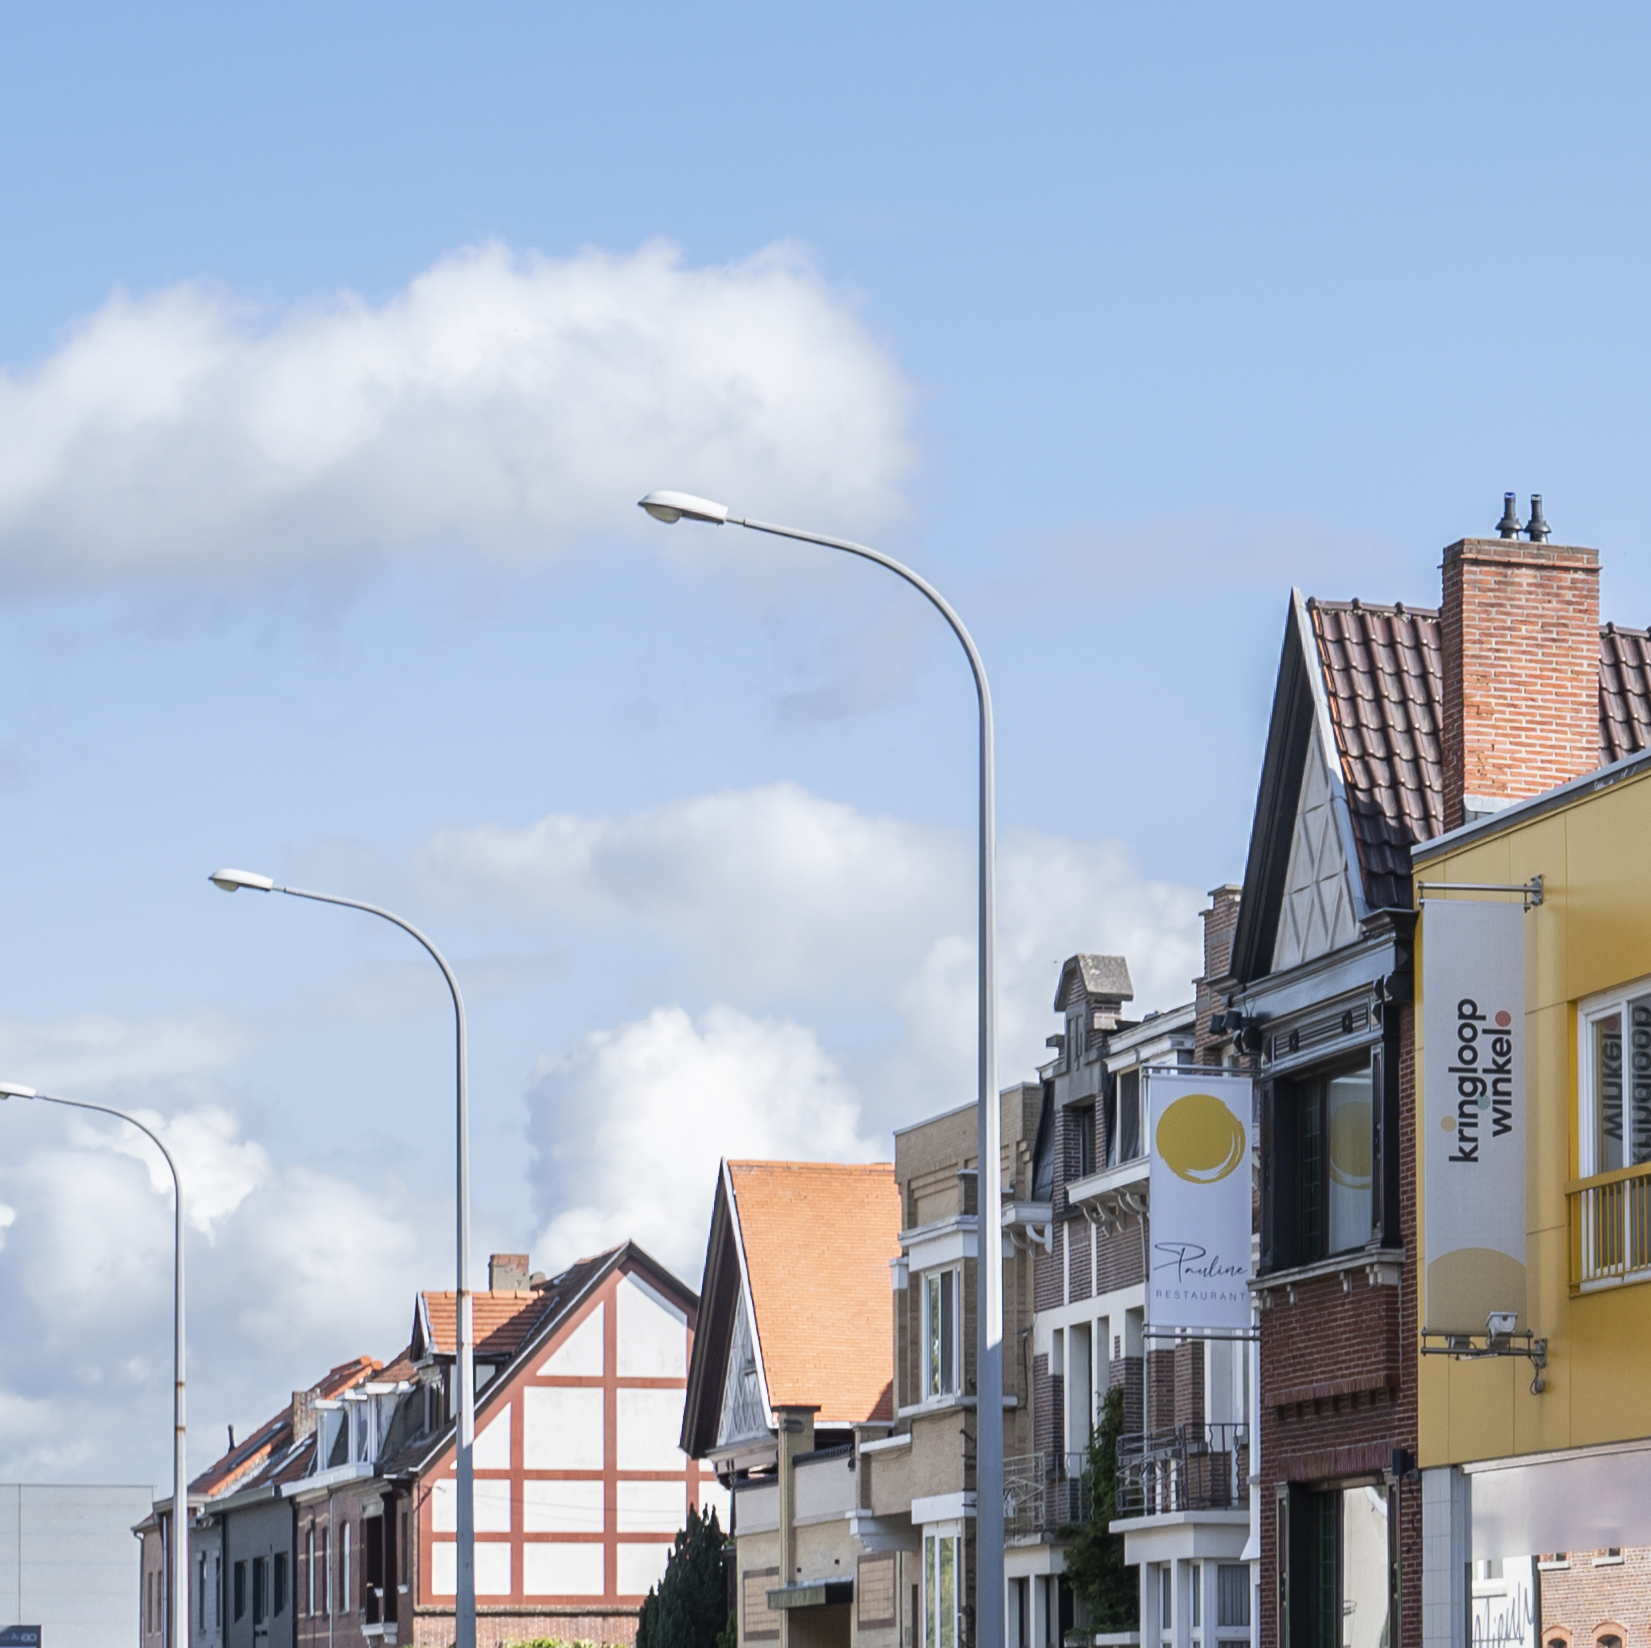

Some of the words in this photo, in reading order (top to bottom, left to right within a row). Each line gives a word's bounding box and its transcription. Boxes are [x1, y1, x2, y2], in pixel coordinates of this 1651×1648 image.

[1447, 998, 1487, 1163] kringloop
[1154, 1242, 1247, 1283] Pauline
[1156, 1290, 1246, 1301] RESTAURANT
